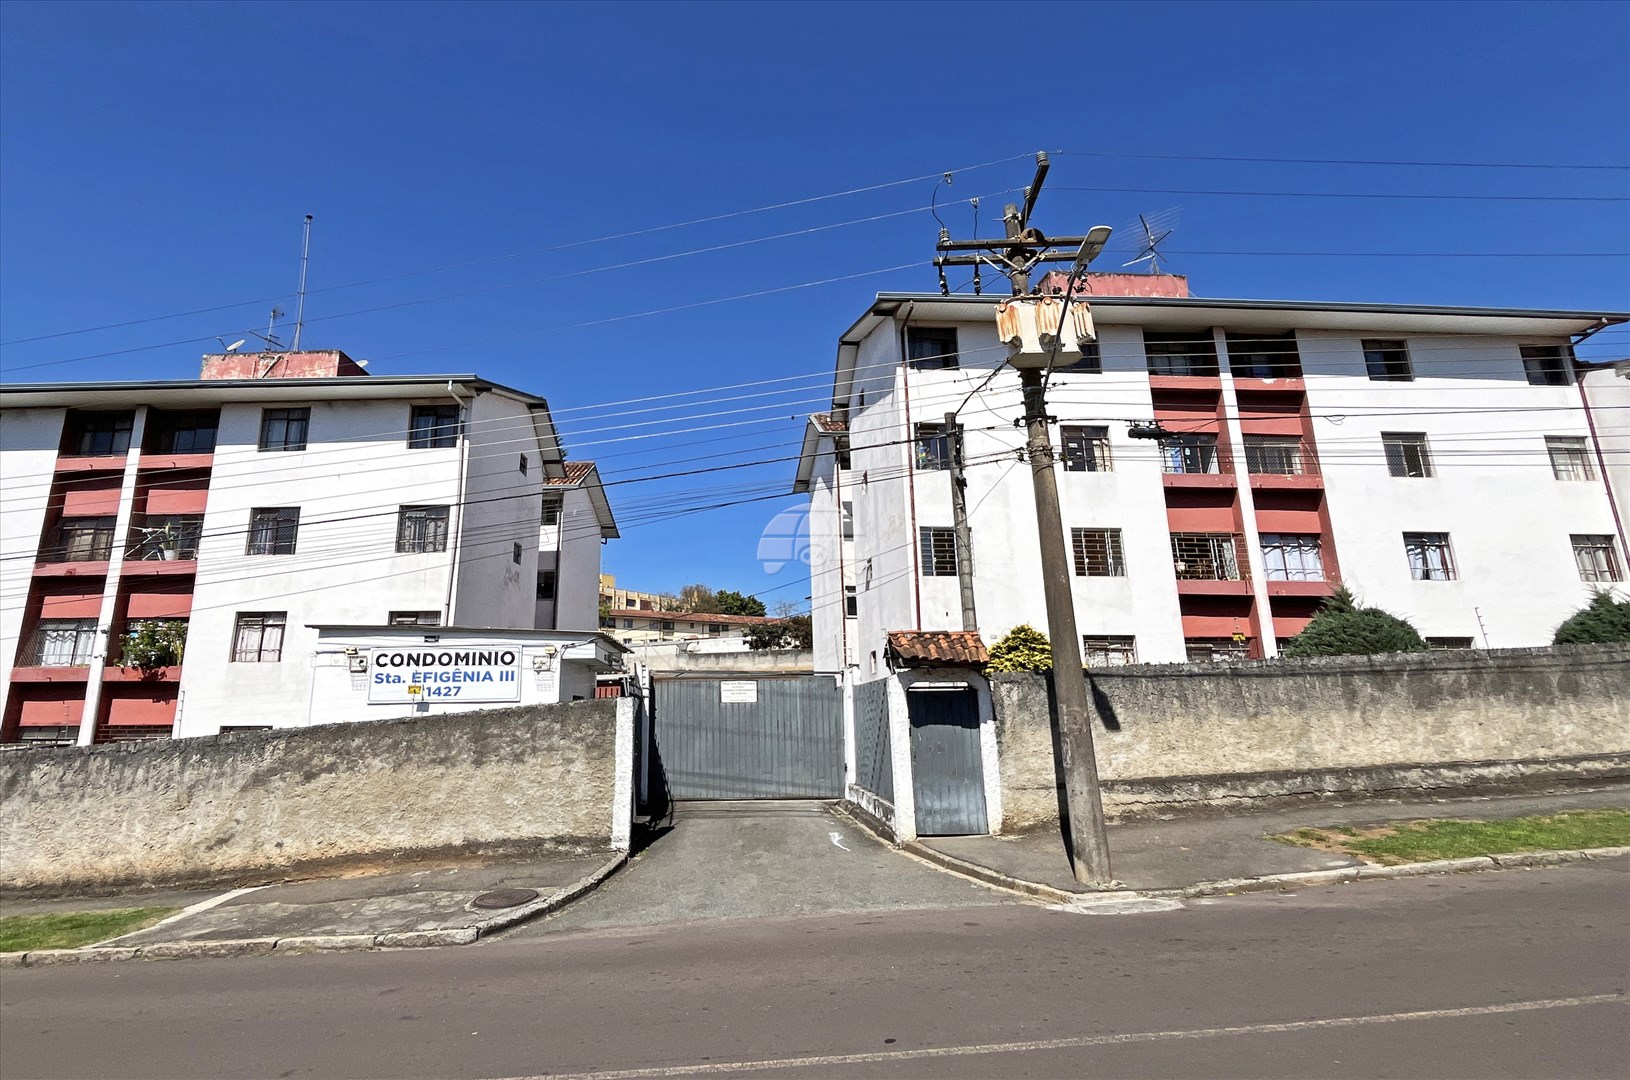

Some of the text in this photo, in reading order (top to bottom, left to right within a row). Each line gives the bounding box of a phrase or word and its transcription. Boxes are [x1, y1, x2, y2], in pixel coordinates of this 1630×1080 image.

[375, 651, 516, 668] CONDOMINIO
[374, 668, 515, 684] Sta. EFIGÊNIA III
[426, 686, 462, 697] 1427
